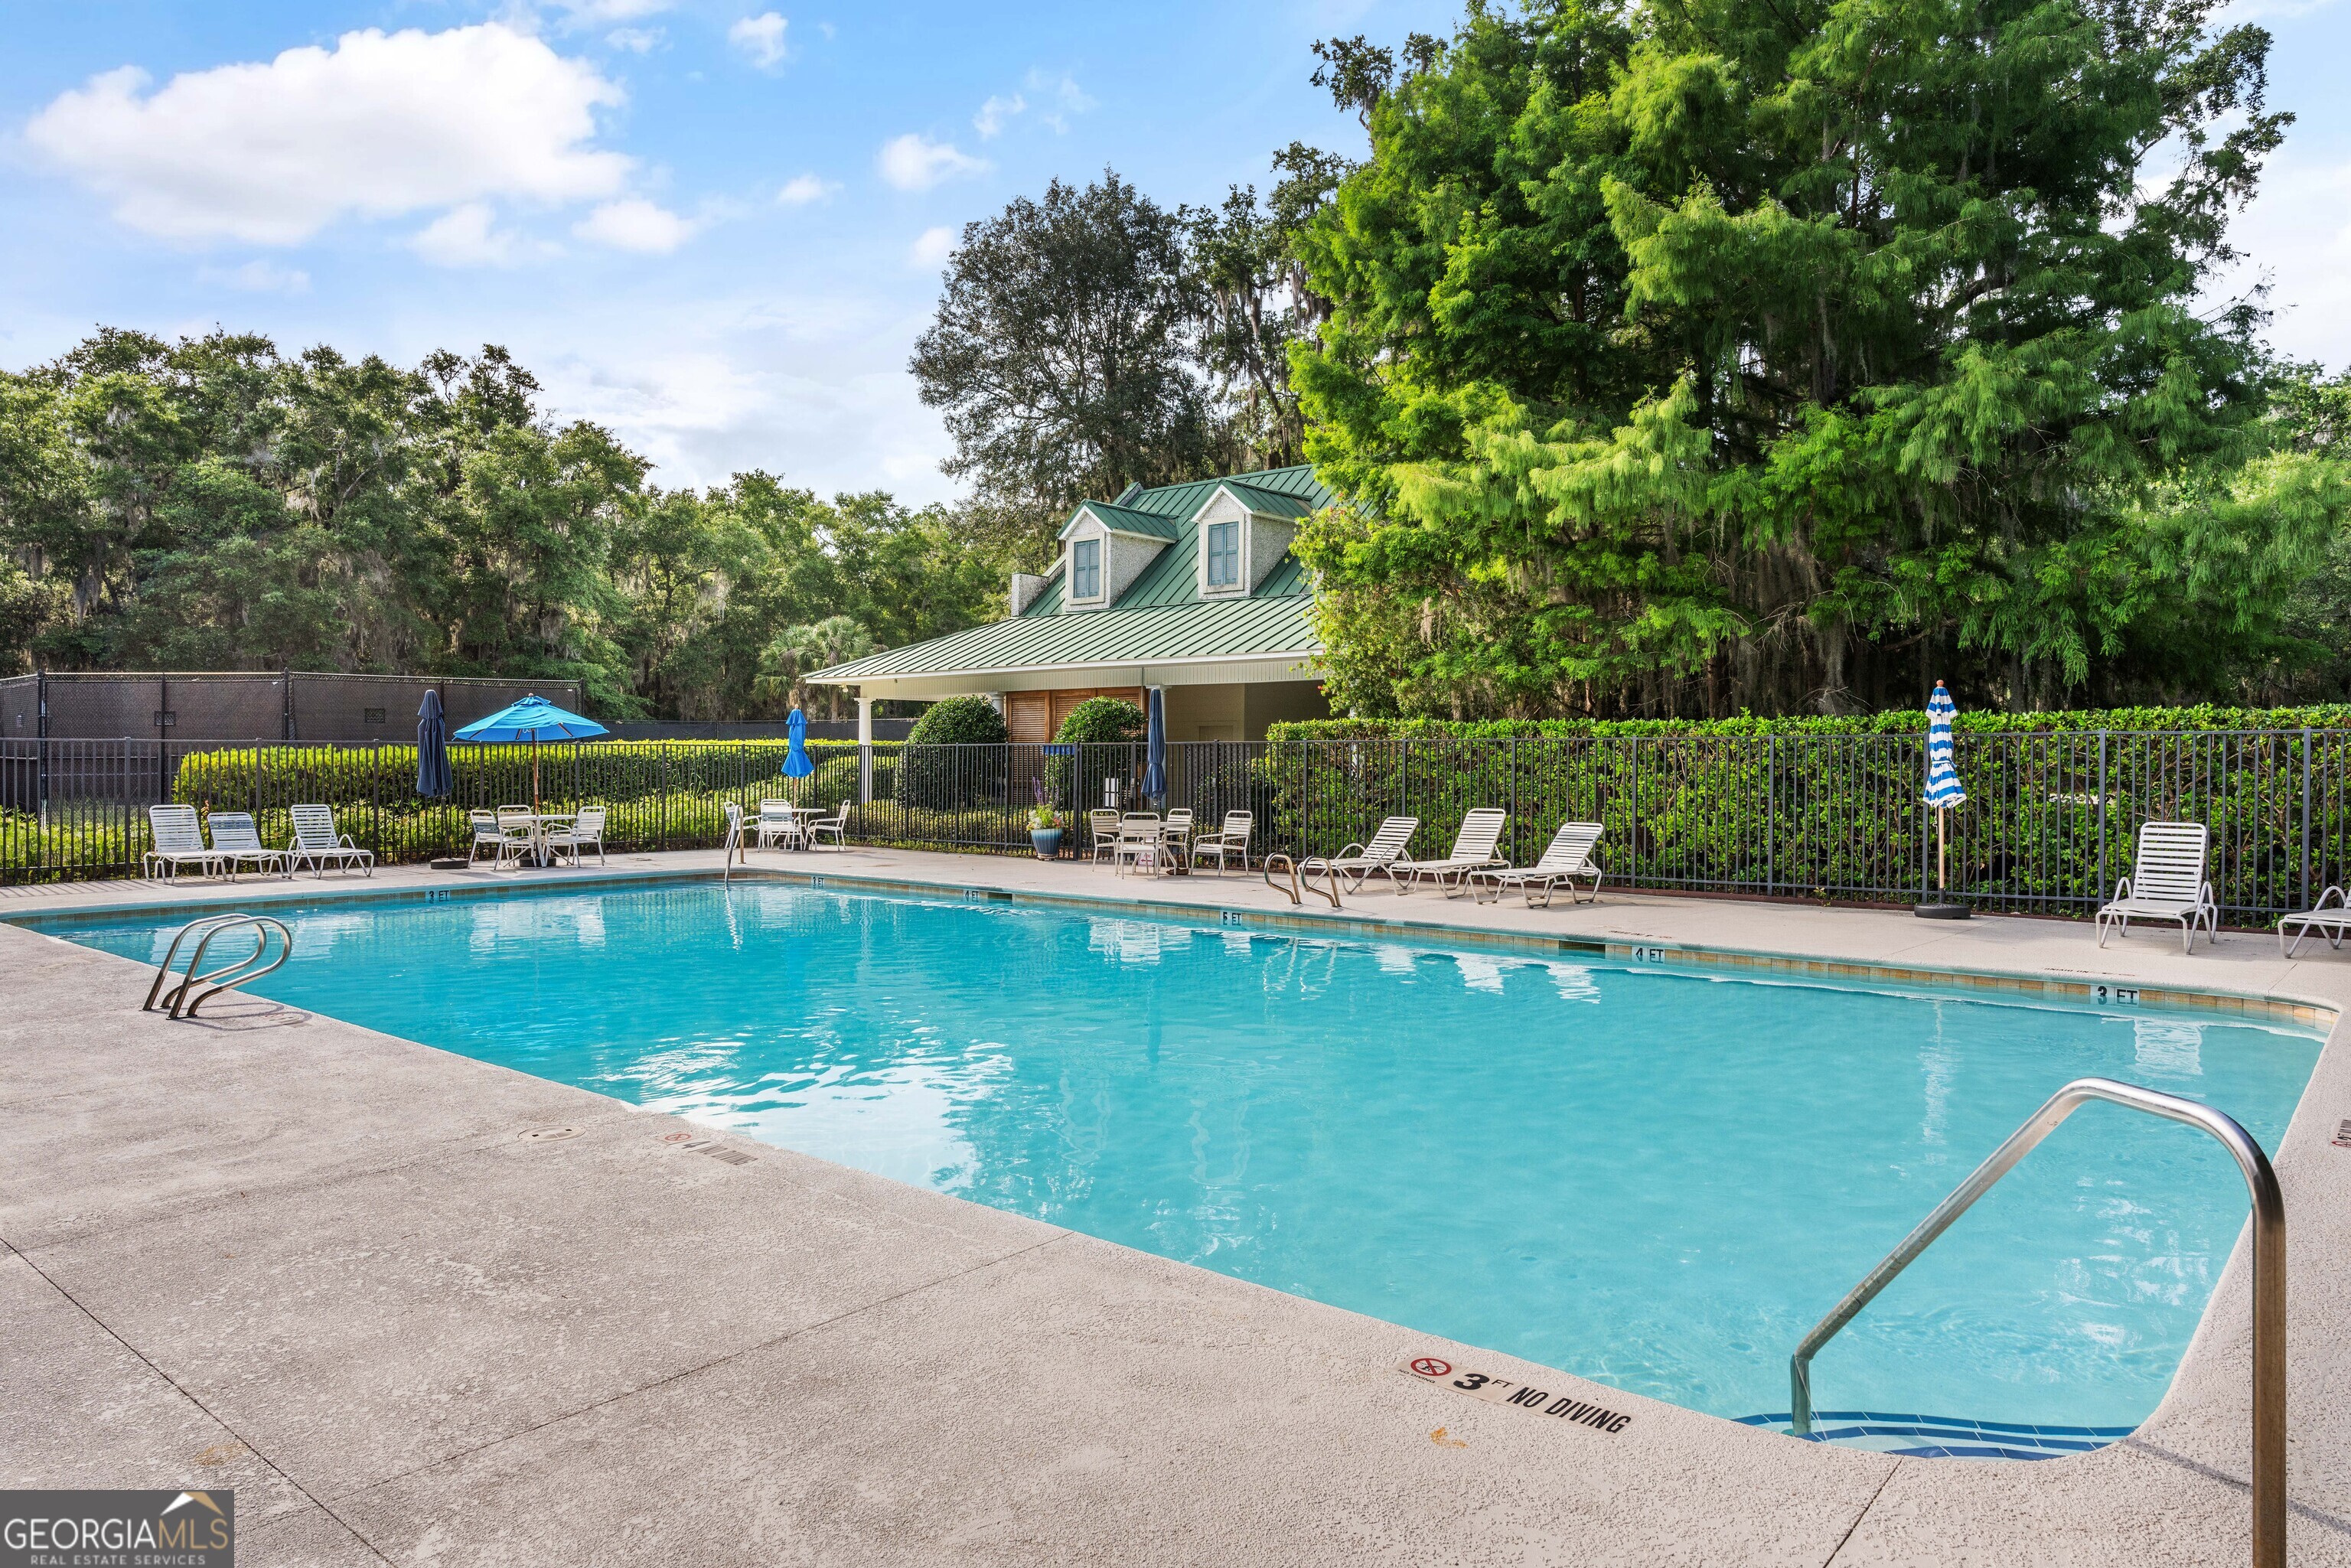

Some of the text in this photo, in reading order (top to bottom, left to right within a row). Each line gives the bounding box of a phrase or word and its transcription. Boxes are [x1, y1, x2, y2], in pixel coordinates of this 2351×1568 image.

[1410, 1373, 1436, 1384] DIVING
[1453, 1373, 1514, 1390] 3 FT
[1505, 1387, 1632, 1434] NO DIVING
